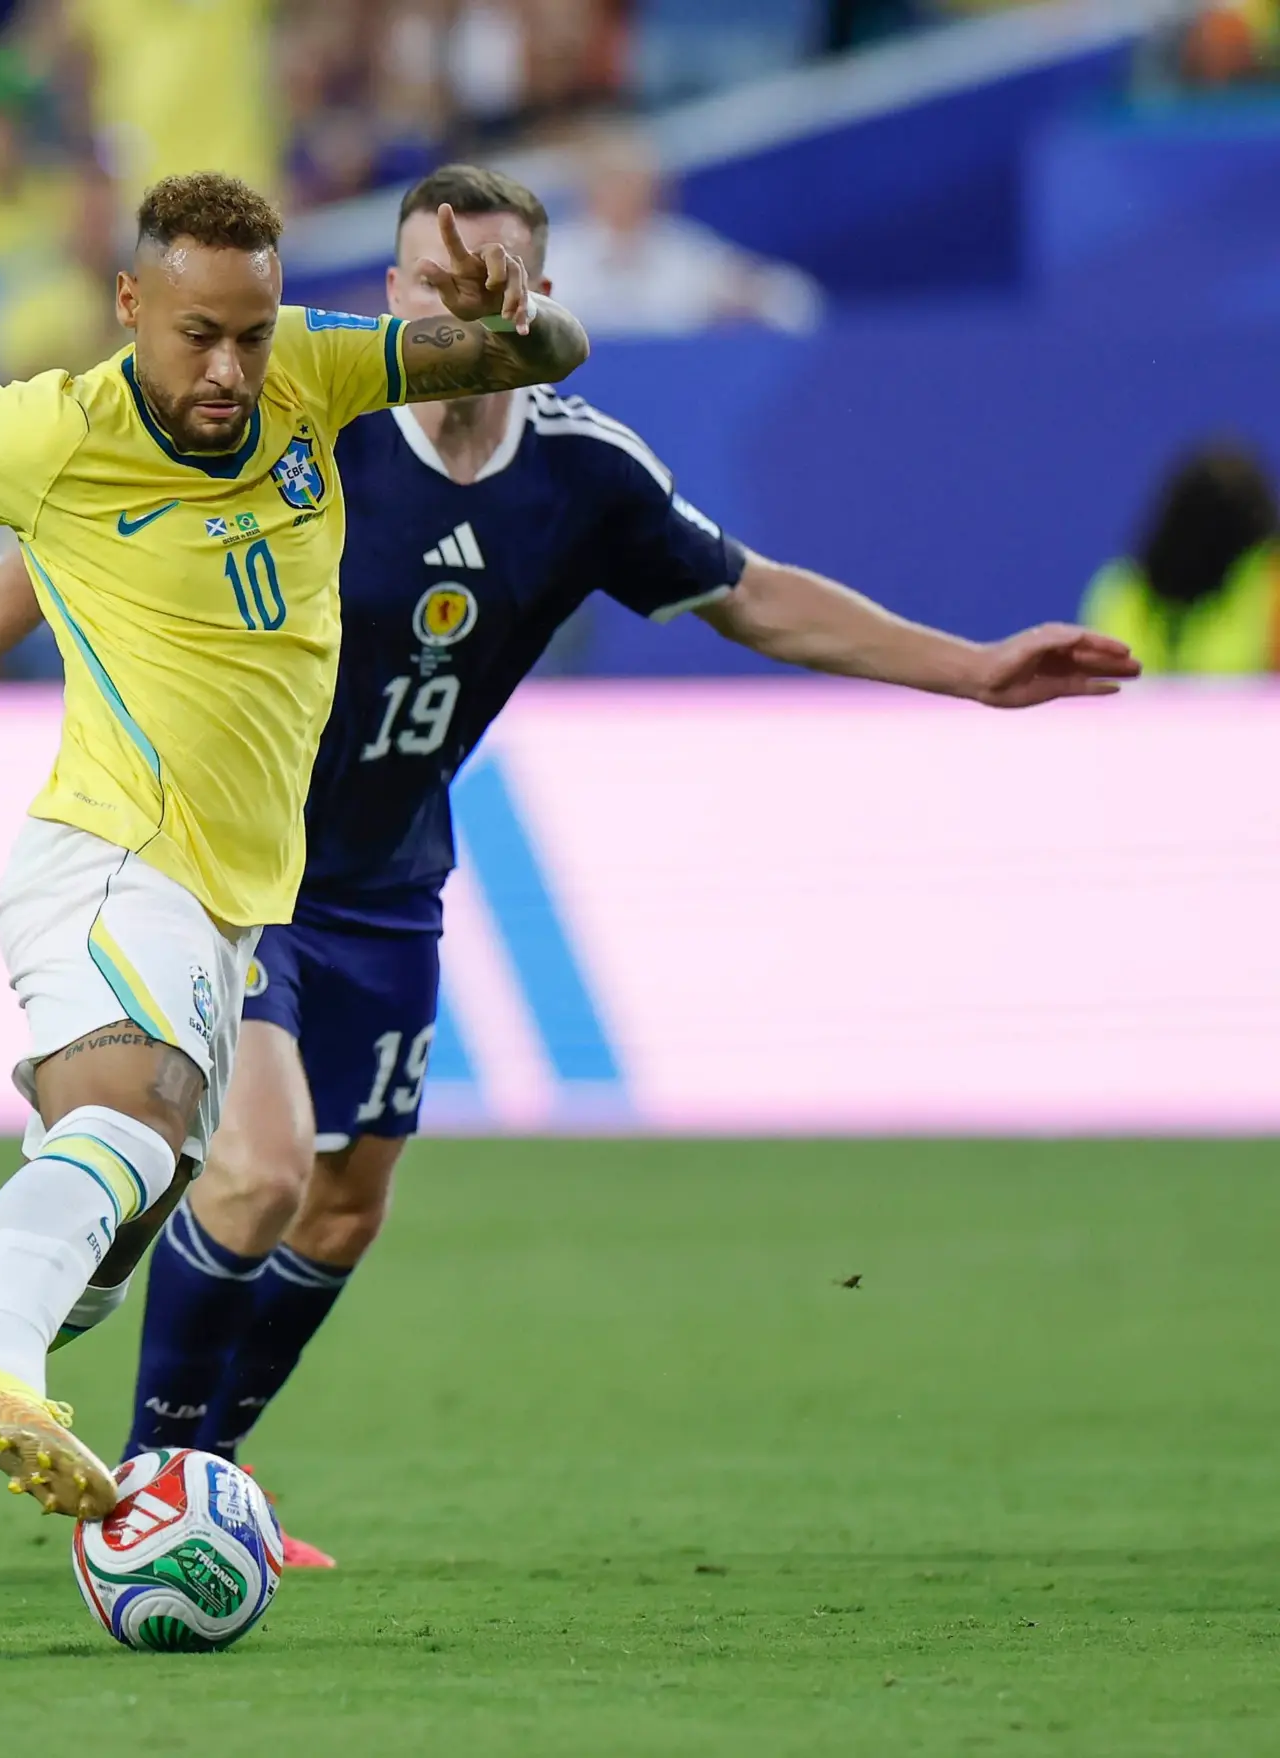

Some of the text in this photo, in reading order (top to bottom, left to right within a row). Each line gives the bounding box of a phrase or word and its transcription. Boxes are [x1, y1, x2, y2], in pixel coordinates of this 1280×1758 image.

[286, 463, 305, 480] CBF
[224, 538, 288, 631] 10
[360, 674, 460, 762] 19
[64, 1042, 85, 1061] EM
[355, 1023, 436, 1122] 19
[195, 1546, 240, 1596] TRIONDA
